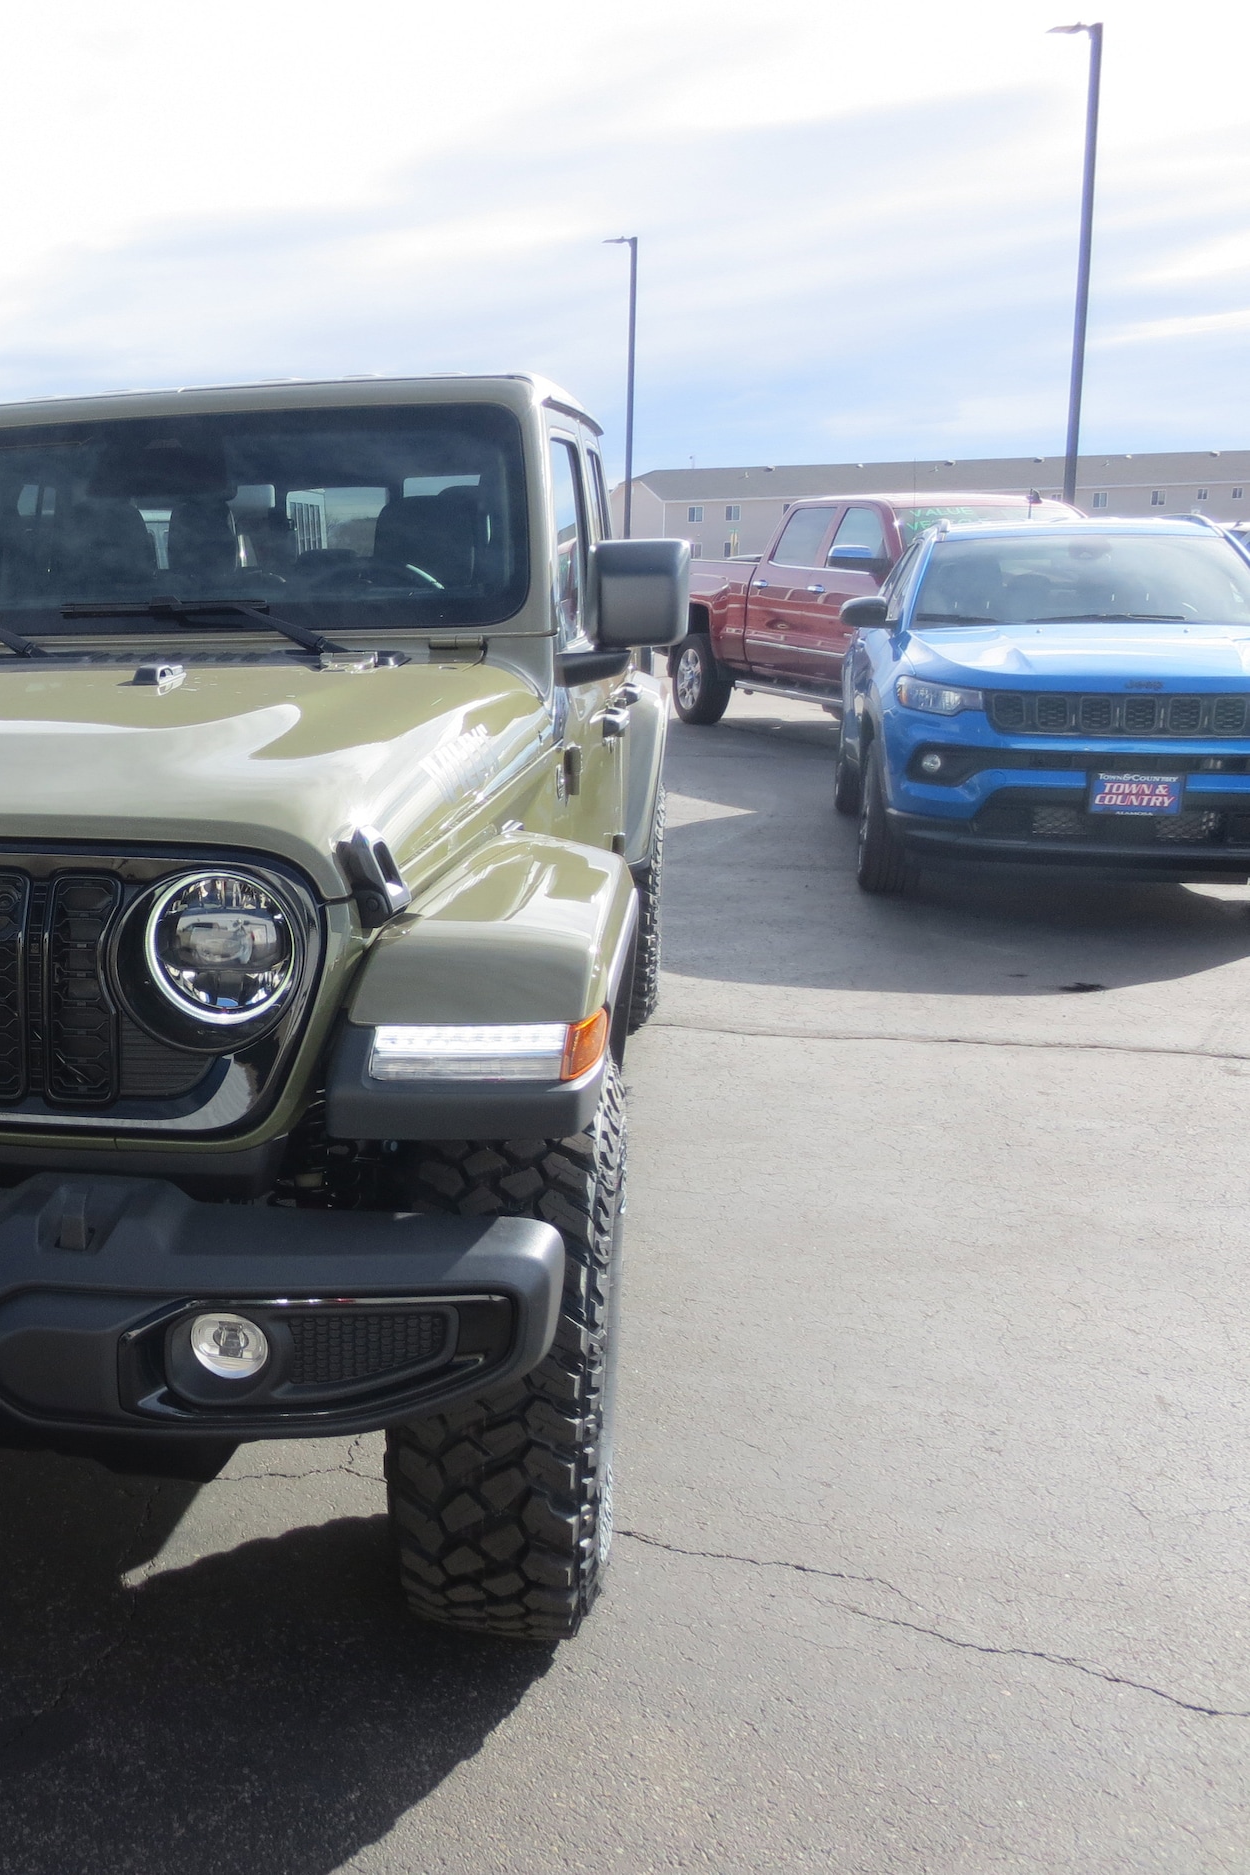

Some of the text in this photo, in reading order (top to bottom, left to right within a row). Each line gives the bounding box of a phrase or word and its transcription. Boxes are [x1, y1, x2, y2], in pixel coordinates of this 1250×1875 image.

[910, 507, 973, 517] VALUE
[1104, 783, 1169, 795] TOWN &
[1094, 794, 1175, 807] COUNTRY
